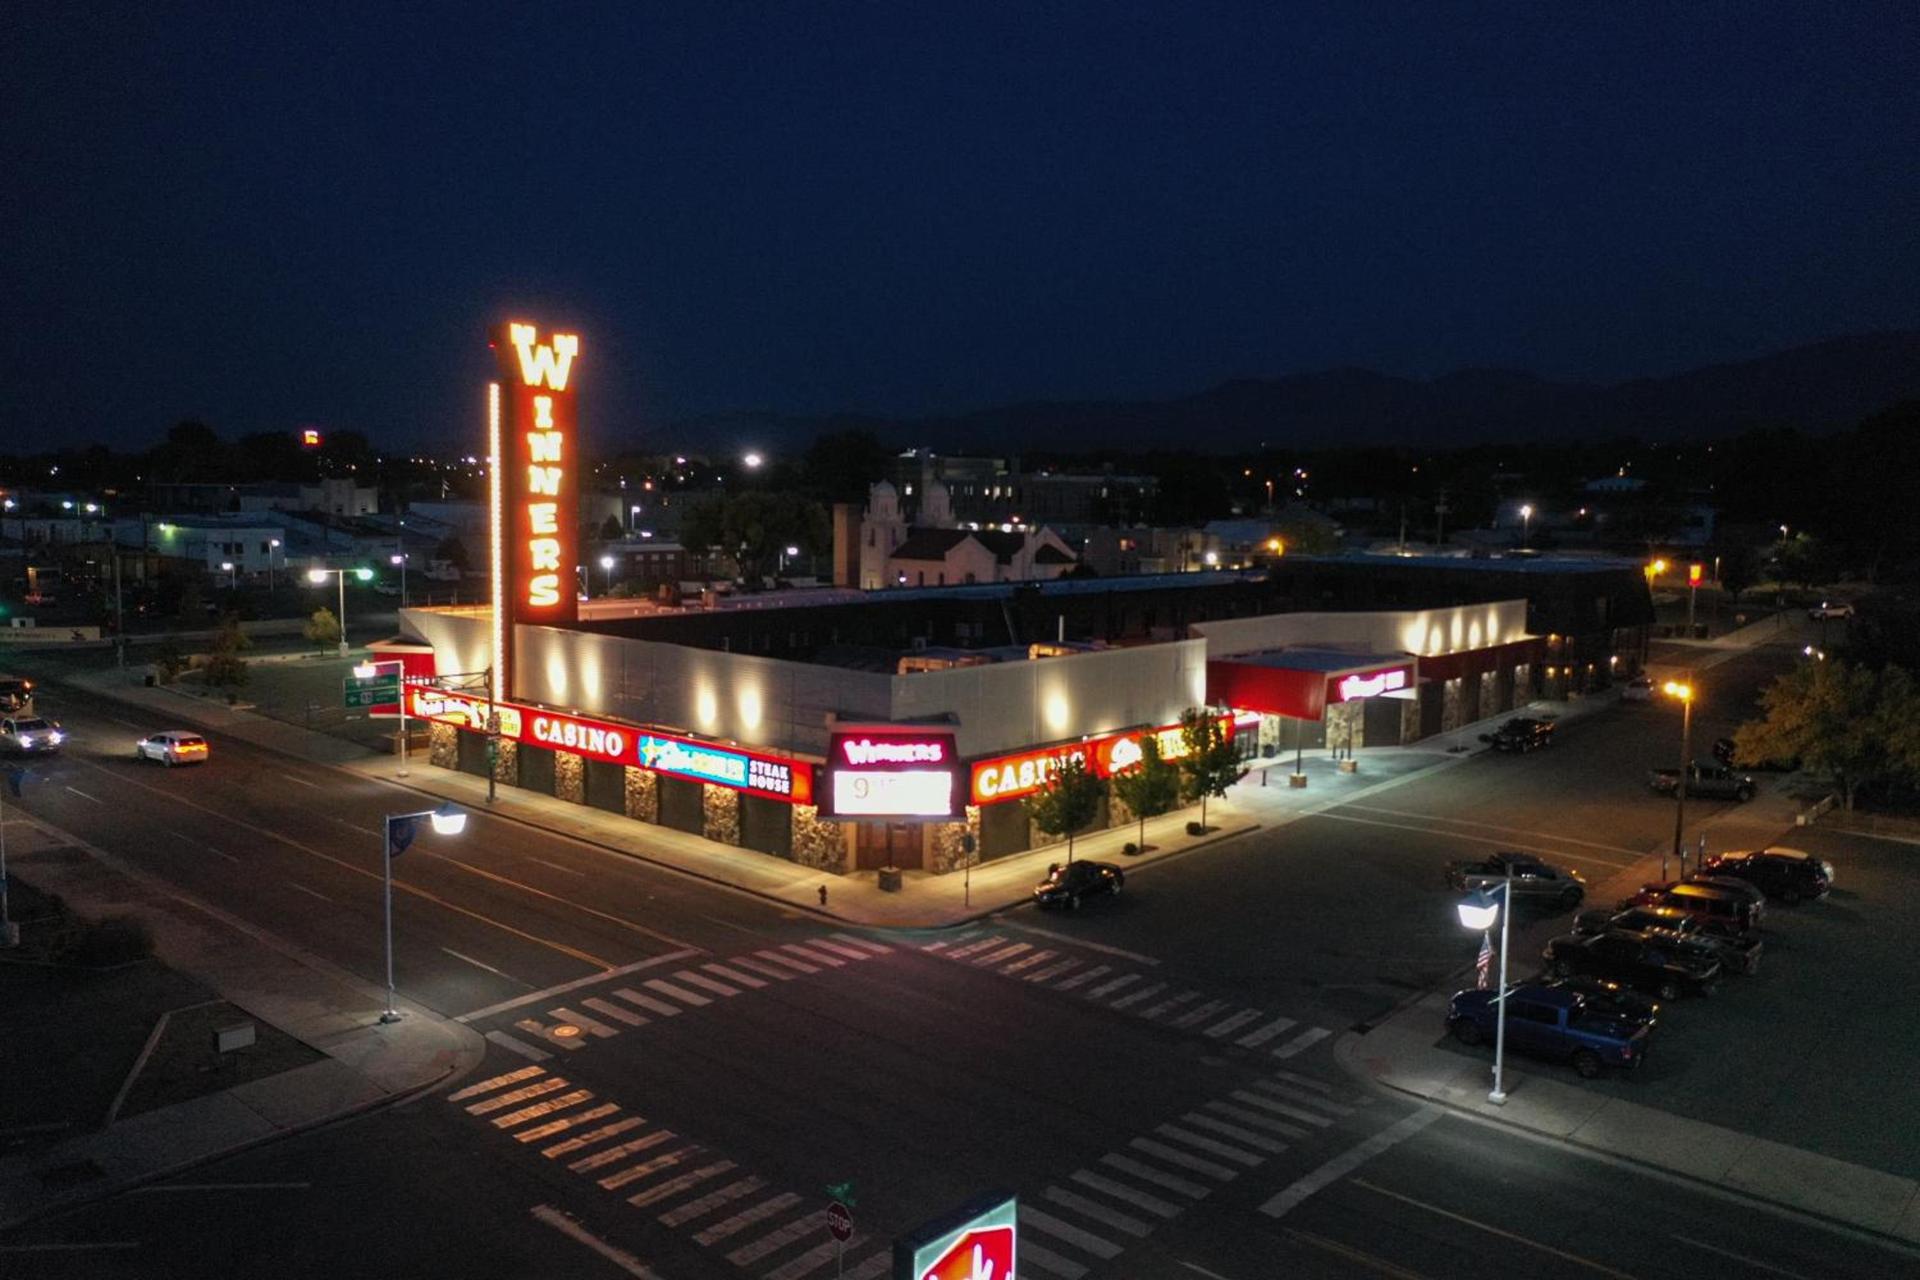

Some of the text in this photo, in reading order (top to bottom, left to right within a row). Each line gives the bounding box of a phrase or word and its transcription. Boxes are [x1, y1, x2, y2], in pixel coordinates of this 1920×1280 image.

[509, 322, 578, 606] WINNERS
[533, 717, 623, 757] CASINO
[750, 760, 788, 780] STEAK
[749, 773, 789, 794] HOUSE
[829, 1211, 851, 1233] STOP
